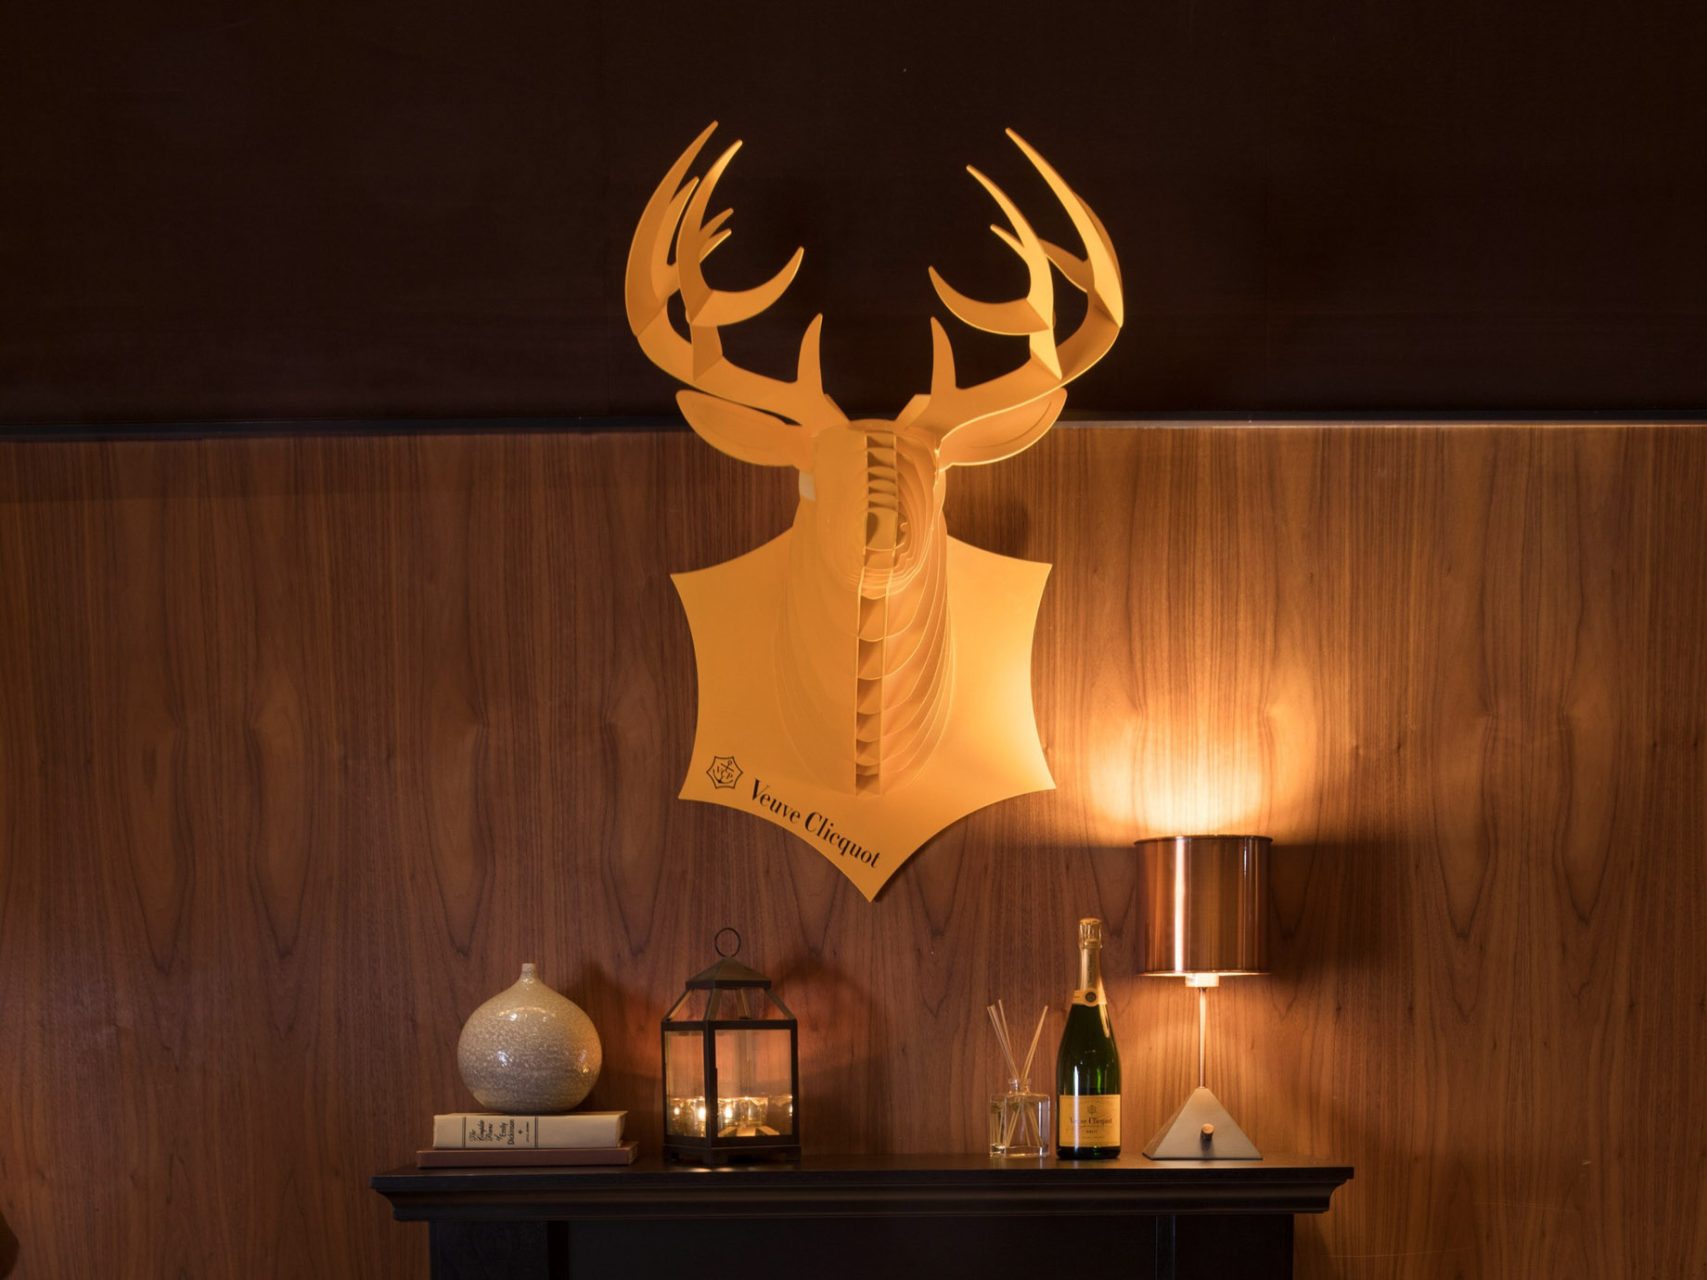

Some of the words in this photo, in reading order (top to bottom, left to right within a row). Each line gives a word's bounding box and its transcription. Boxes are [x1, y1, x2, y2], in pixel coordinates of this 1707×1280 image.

[751, 777, 801, 823] Veuve
[804, 811, 881, 869] Clicquot
[499, 1122, 508, 1137] Emily
